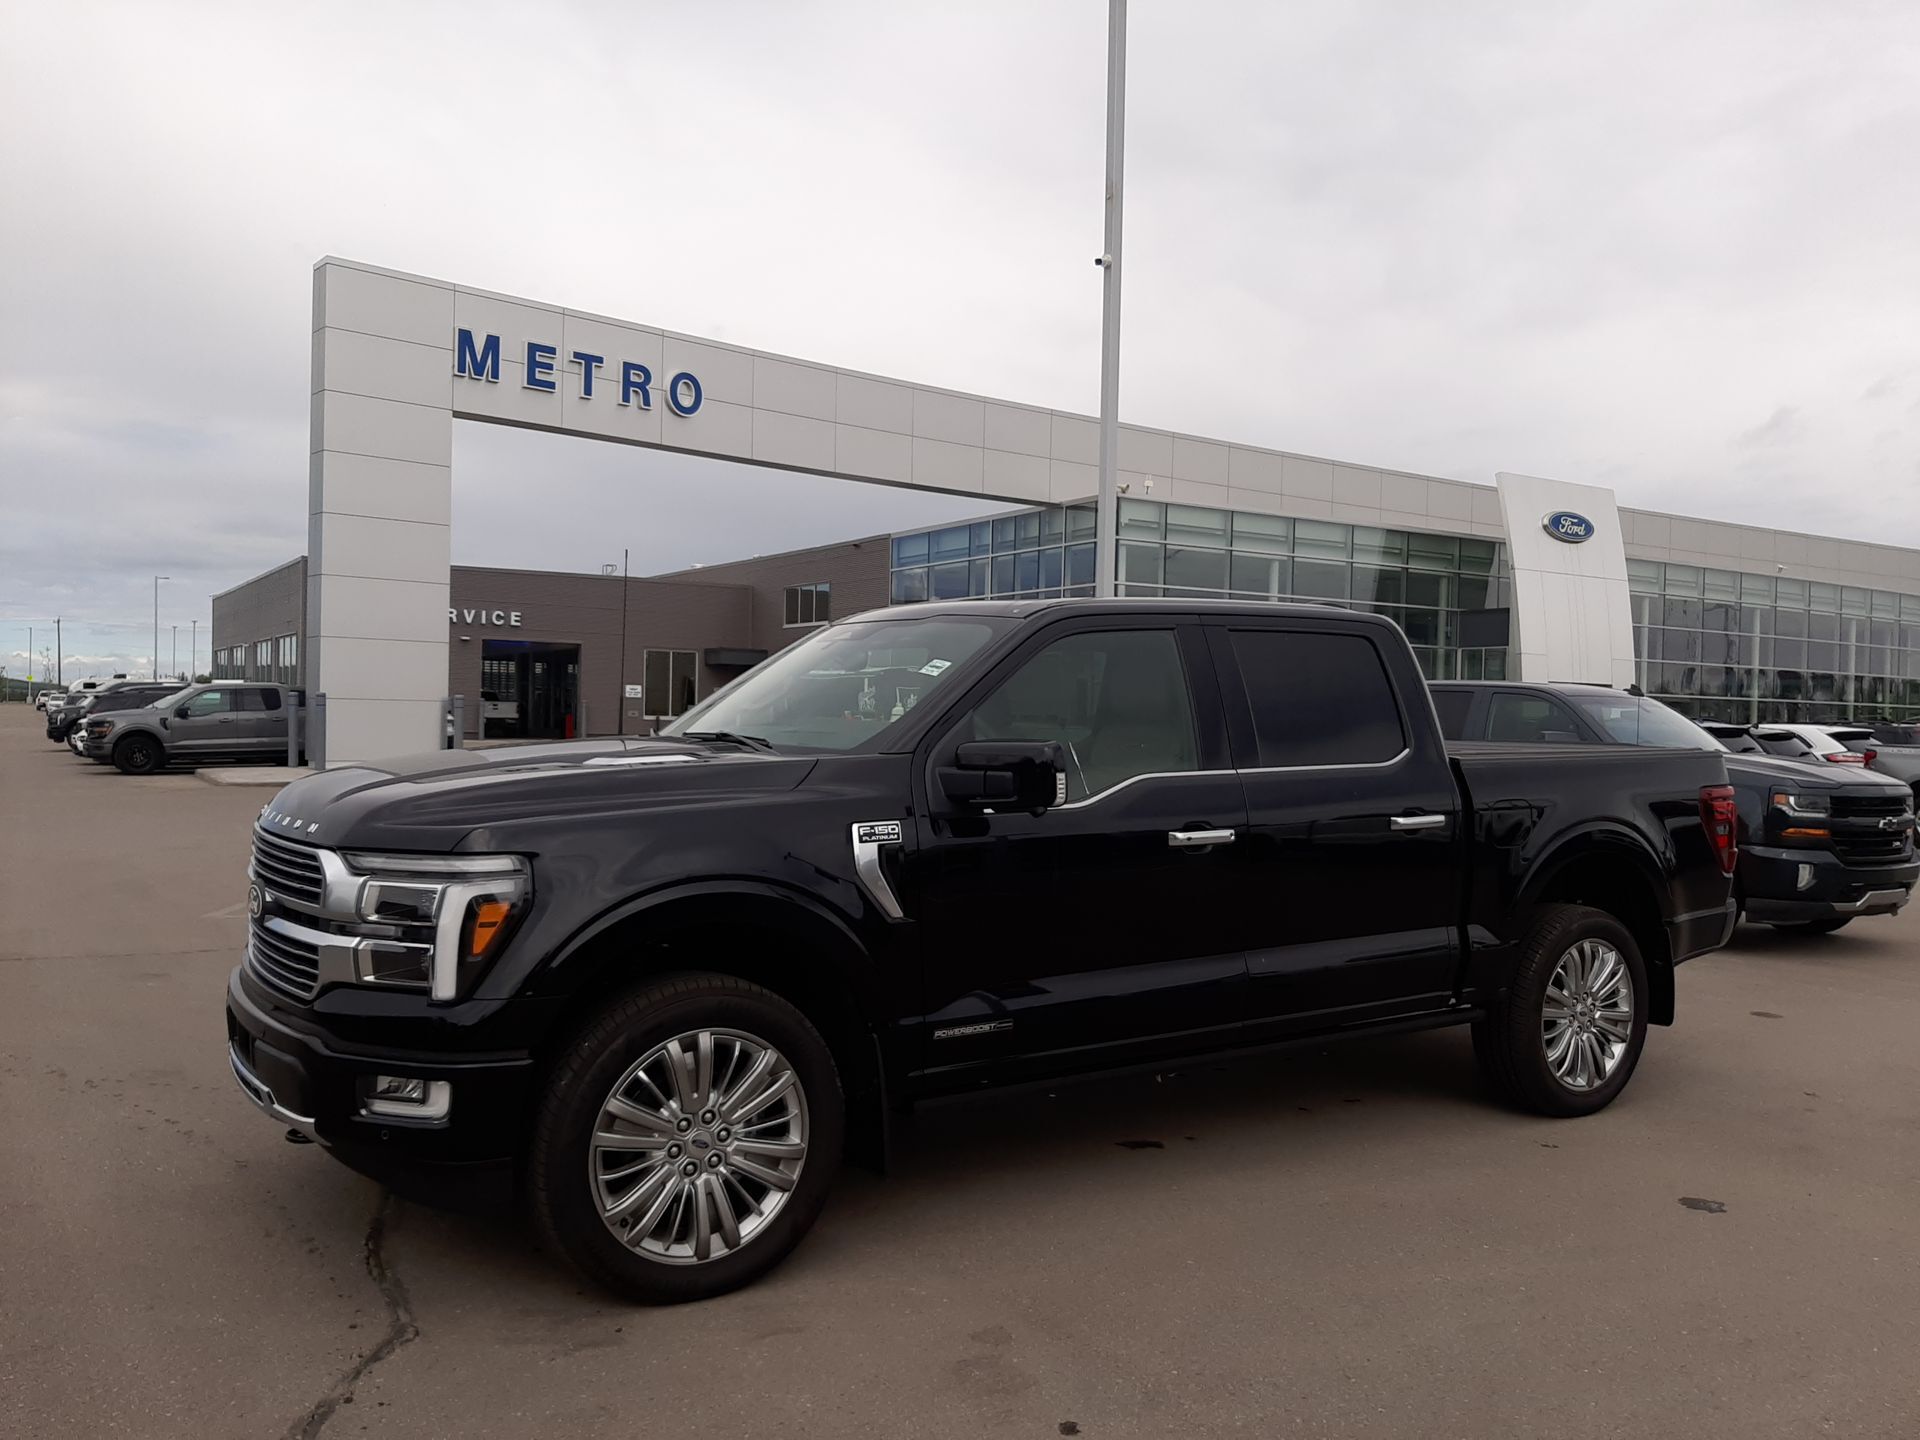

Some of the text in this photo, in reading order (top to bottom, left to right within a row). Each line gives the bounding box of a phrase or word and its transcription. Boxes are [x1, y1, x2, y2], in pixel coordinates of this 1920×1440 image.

[454, 327, 703, 418] METRO
[1559, 516, 1585, 535] Ford
[859, 825, 899, 835] F-150
[934, 1023, 996, 1038] POWERBOOST
